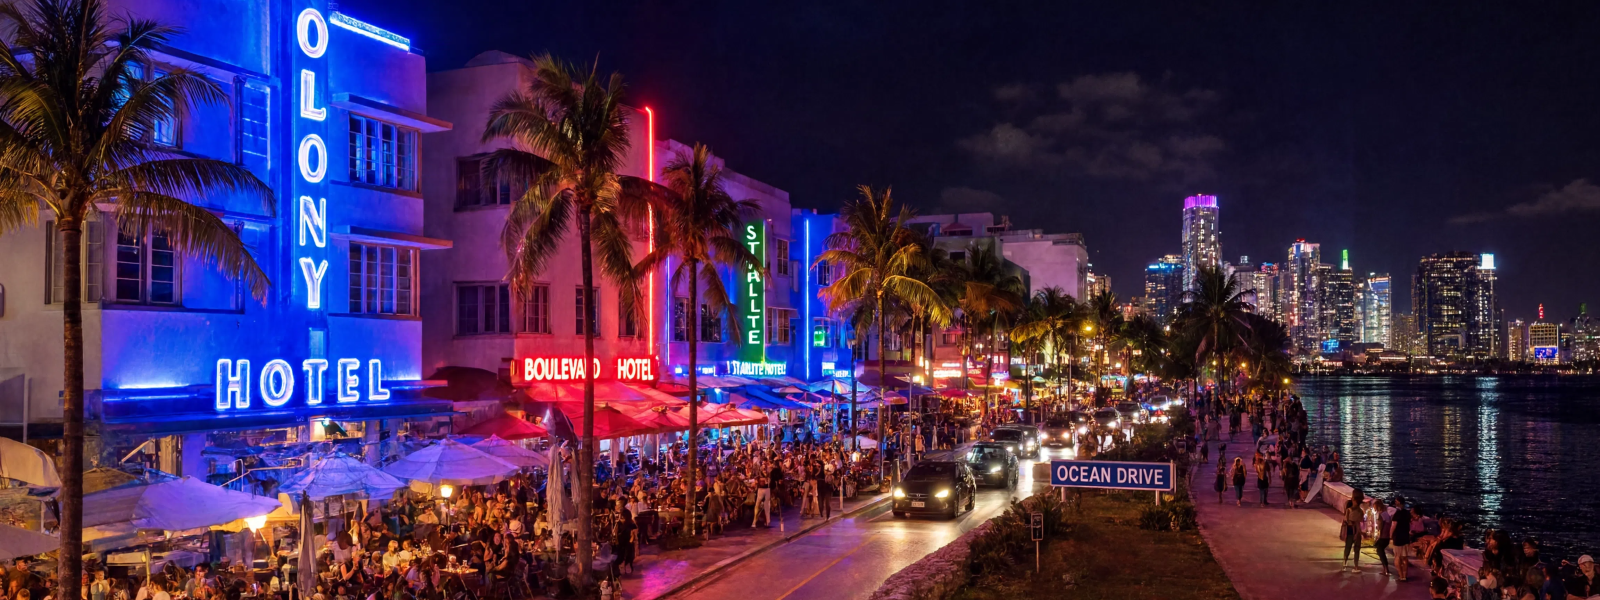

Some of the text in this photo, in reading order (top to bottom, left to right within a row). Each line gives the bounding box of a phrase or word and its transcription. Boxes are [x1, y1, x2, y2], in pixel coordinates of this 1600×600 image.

[524, 357, 654, 381] BOULEVAD HOTEL
[216, 358, 390, 410] HOTEL
[1056, 465, 1164, 485] OCEAN DRIVE
